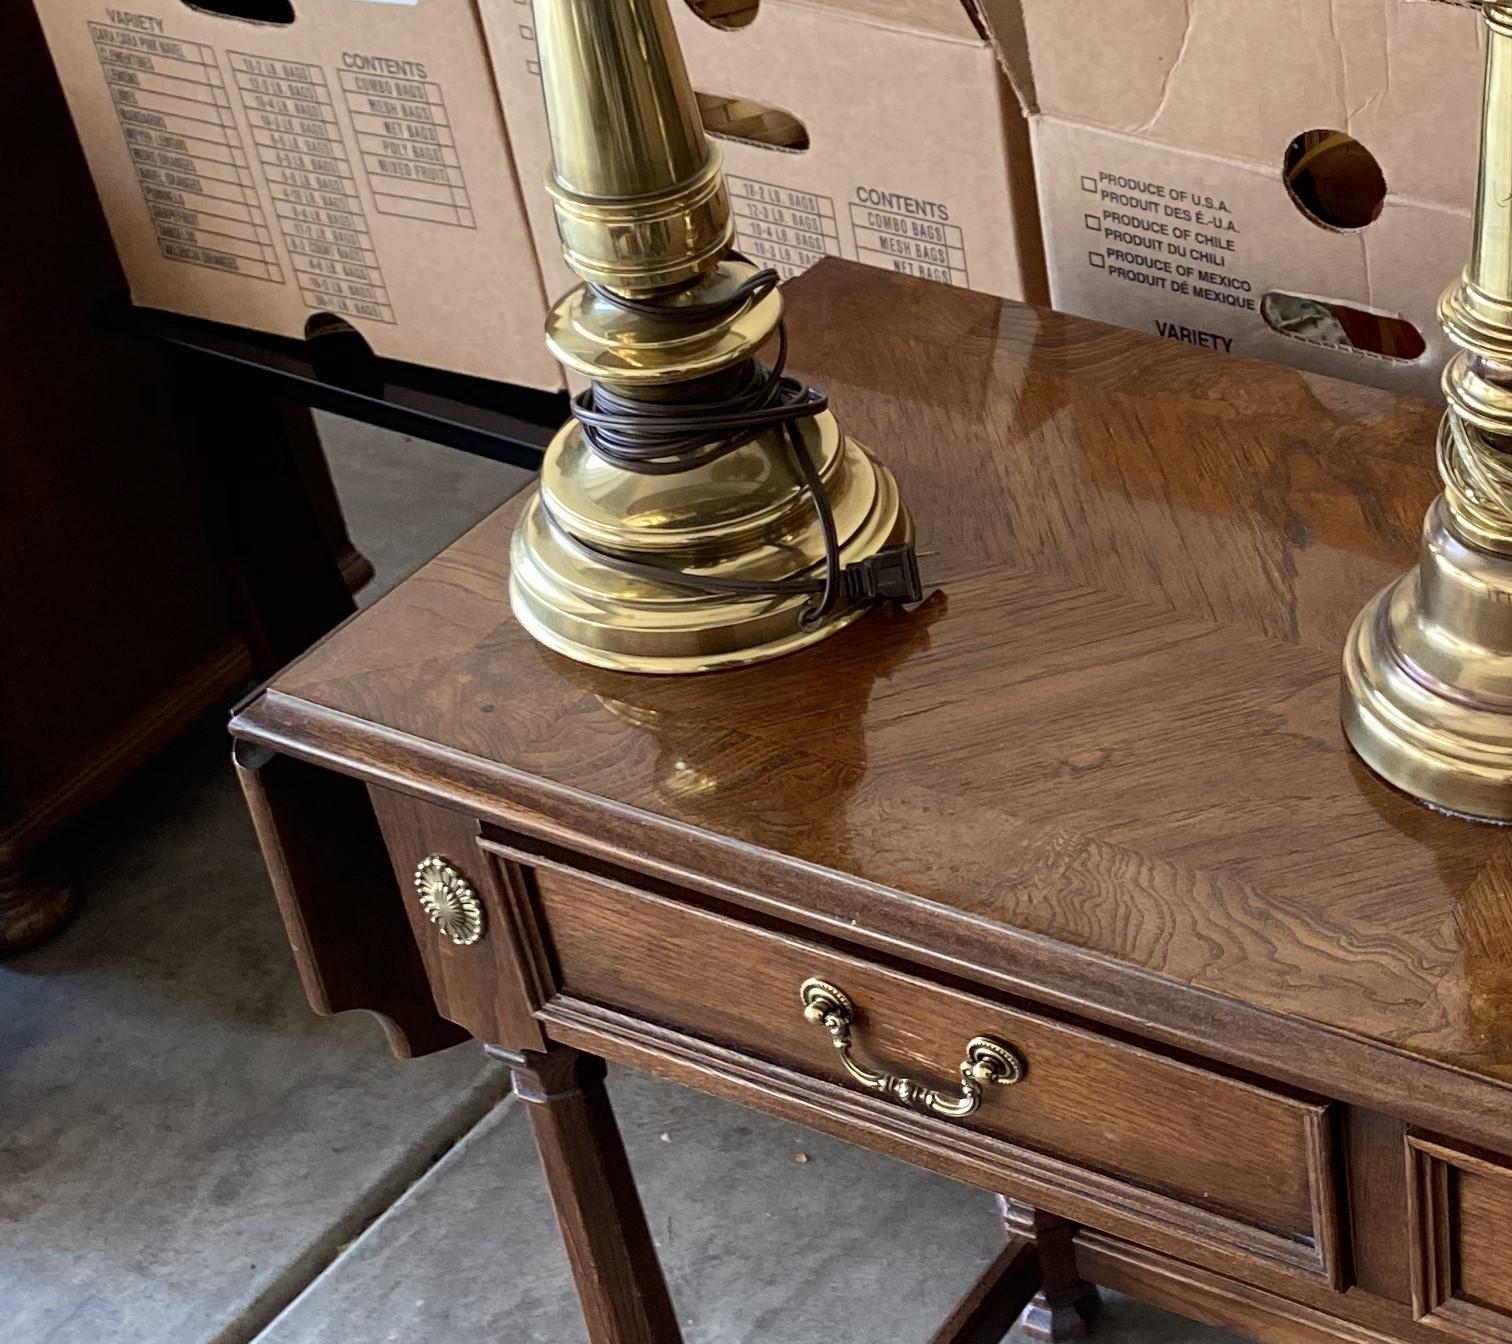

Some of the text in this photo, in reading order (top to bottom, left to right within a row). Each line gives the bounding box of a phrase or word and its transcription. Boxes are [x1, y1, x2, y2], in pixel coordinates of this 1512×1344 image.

[105, 8, 164, 34] VARIETY
[342, 51, 427, 79] CONTENTS
[788, 193, 816, 212] BAGS
[856, 186, 950, 221] CONTENTS
[1099, 171, 1232, 214] PRODUCE OF U.S.A.
[1101, 189, 1160, 214] PRODUIT
[1164, 205, 1192, 222] DES
[791, 213, 819, 232] BAGS
[868, 211, 944, 243] COMBO BAGS
[1103, 210, 1236, 252] PRODUCE OF CHILE
[795, 232, 823, 251] BAGS
[879, 235, 946, 264] MESH BAGS
[1104, 228, 1225, 267] PRODUIT DU CHILI
[1106, 247, 1252, 293] PRODUCE OF MEXICO
[1108, 265, 1167, 289] PRODUIT
[1193, 285, 1256, 311] MEXIQUE
[1155, 319, 1233, 354] VARIETY
